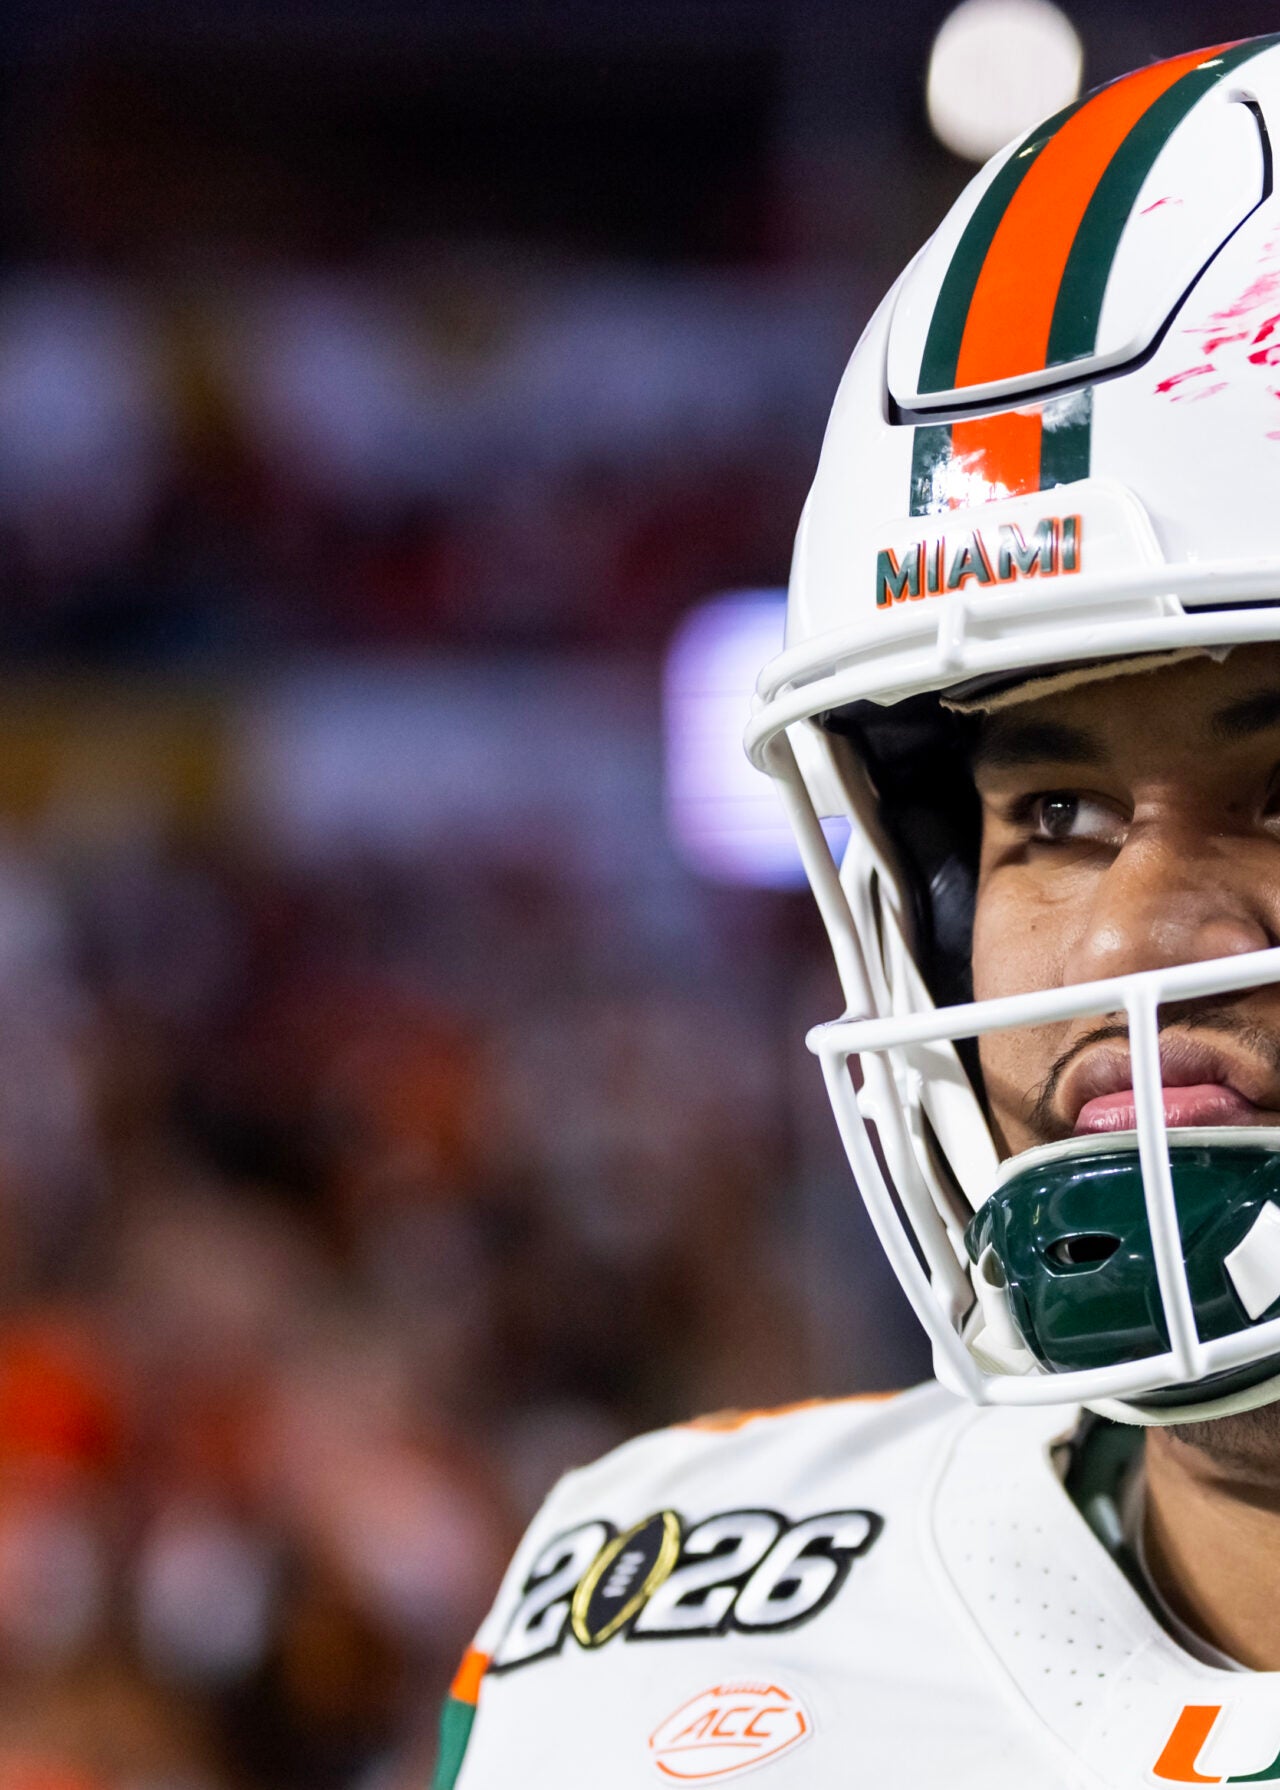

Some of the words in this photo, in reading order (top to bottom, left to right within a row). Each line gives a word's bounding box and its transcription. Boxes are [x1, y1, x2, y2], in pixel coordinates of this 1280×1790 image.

[876, 514, 1082, 609] MIAMI
[487, 1508, 885, 1676] 2026
[670, 1706, 790, 1744] ACC
